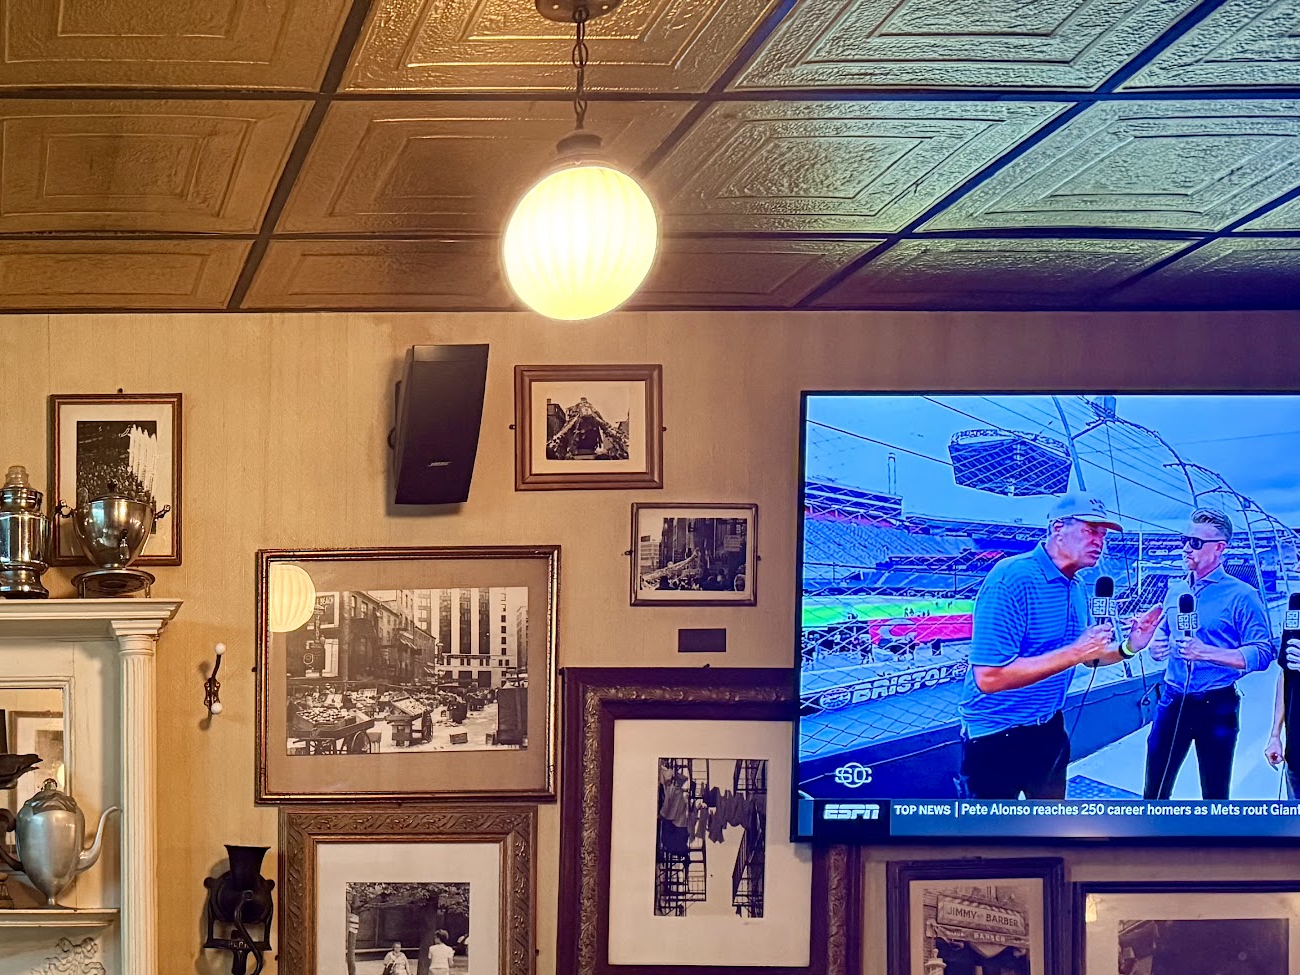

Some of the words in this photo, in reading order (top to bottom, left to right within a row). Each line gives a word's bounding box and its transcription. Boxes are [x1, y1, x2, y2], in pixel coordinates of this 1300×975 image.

[851, 668, 950, 703] BRISTOL
[823, 803, 880, 820] ESPN
[894, 804, 917, 816] TOP
[919, 804, 951, 816] NEWS
[961, 803, 988, 816] Pete
[990, 803, 1031, 816] Alonso
[1033, 803, 1079, 816] reaches
[1081, 803, 1105, 816] 250
[1107, 804, 1144, 816] career
[1147, 803, 1192, 816] homers
[1194, 805, 1208, 816] as
[1211, 803, 1240, 816] Mets
[1242, 804, 1269, 816] rout
[947, 906, 977, 919] JIMMY
[986, 914, 1020, 927] BARBER
